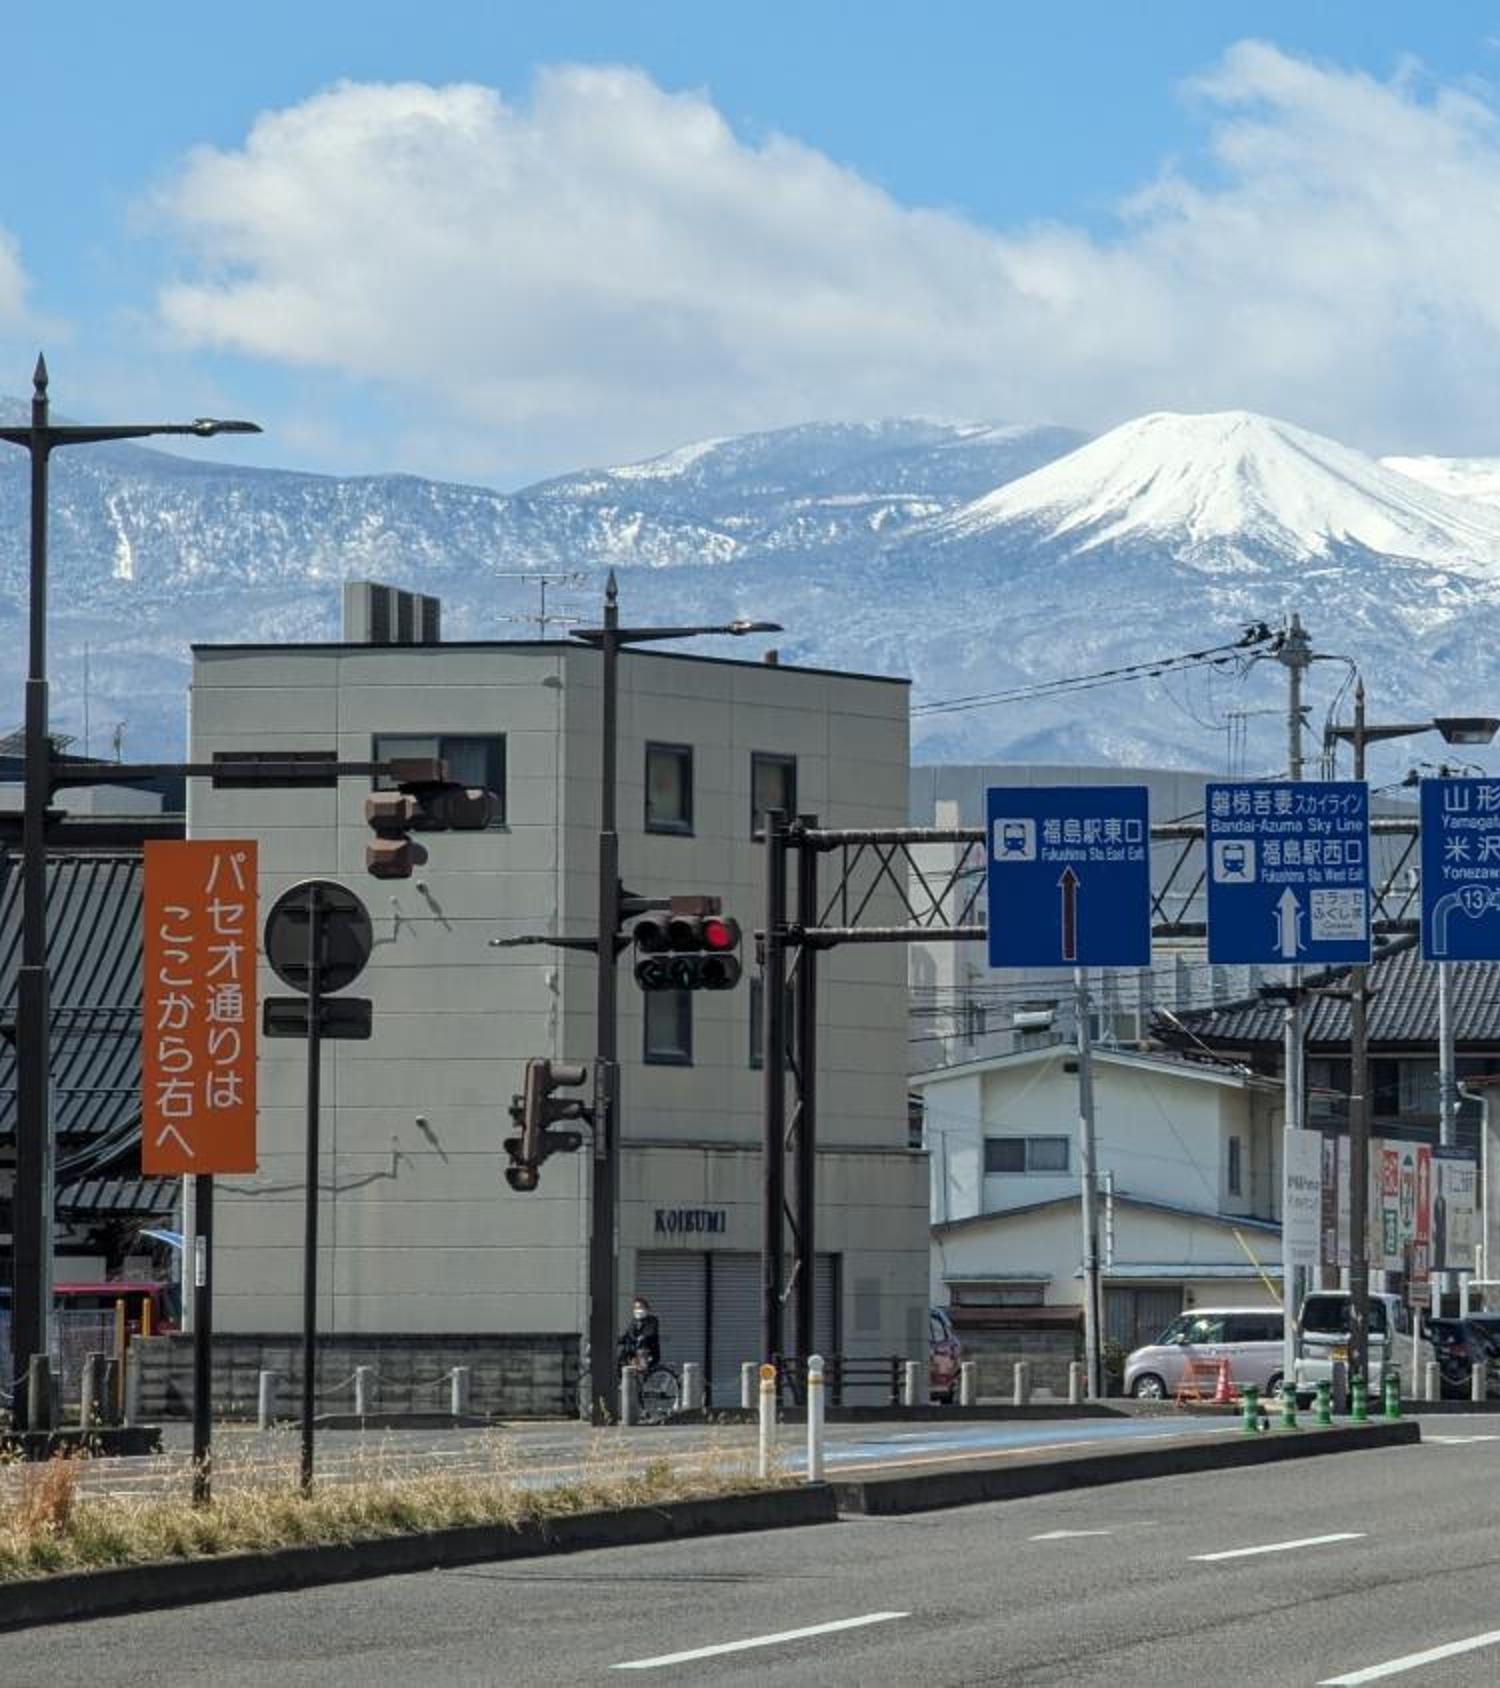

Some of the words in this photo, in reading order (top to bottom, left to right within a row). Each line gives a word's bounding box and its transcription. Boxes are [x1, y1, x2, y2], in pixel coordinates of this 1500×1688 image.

[1043, 817, 1143, 845] 福島駅東口
[1211, 819, 1302, 833] Bandai-Azuma
[1307, 818, 1332, 835] Sky
[1336, 818, 1363, 832] Line
[1262, 839, 1362, 866] 福島駅西口
[1464, 889, 1484, 910] 13
[205, 852, 248, 1109] パセオ通りは
[156, 905, 195, 1158] ここから右へ
